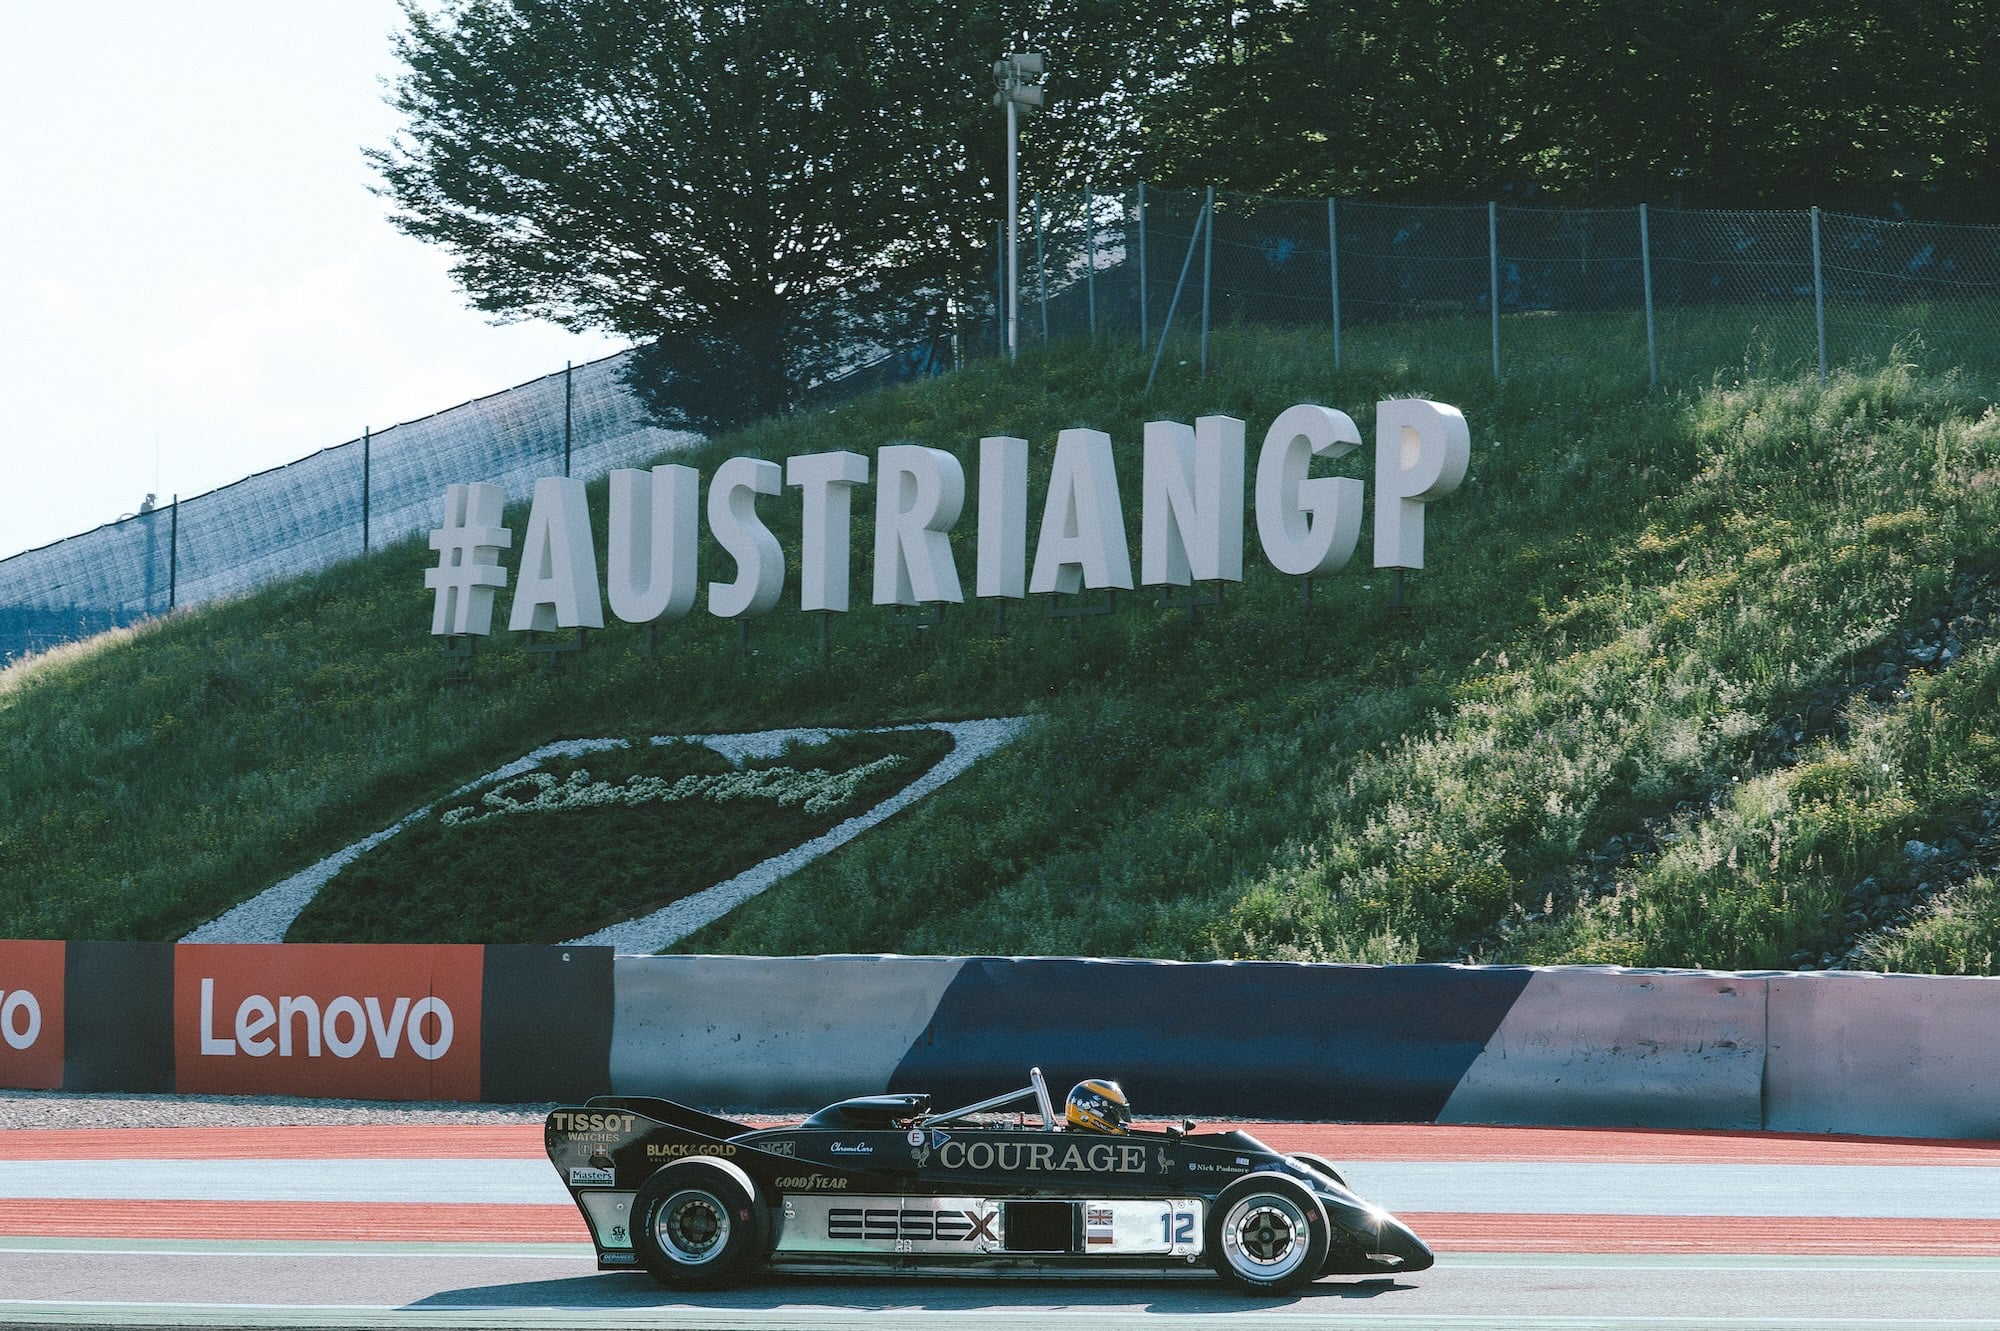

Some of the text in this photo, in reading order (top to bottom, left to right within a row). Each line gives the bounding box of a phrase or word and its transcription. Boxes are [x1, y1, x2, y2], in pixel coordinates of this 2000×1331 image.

[424, 398, 1471, 636] #AUSTRIANGP
[201, 978, 454, 1060] Lenovo
[553, 1112, 636, 1133] TISSOT
[568, 1132, 620, 1142] WATCHES
[912, 1132, 920, 1143] E
[940, 1141, 1147, 1173] COURAGE
[1197, 1163, 1214, 1172] Nick
[1216, 1165, 1250, 1174] Padmore
[572, 1170, 612, 1180] Masters
[828, 1208, 999, 1241] ESSEX
[1161, 1213, 1194, 1243] 12
